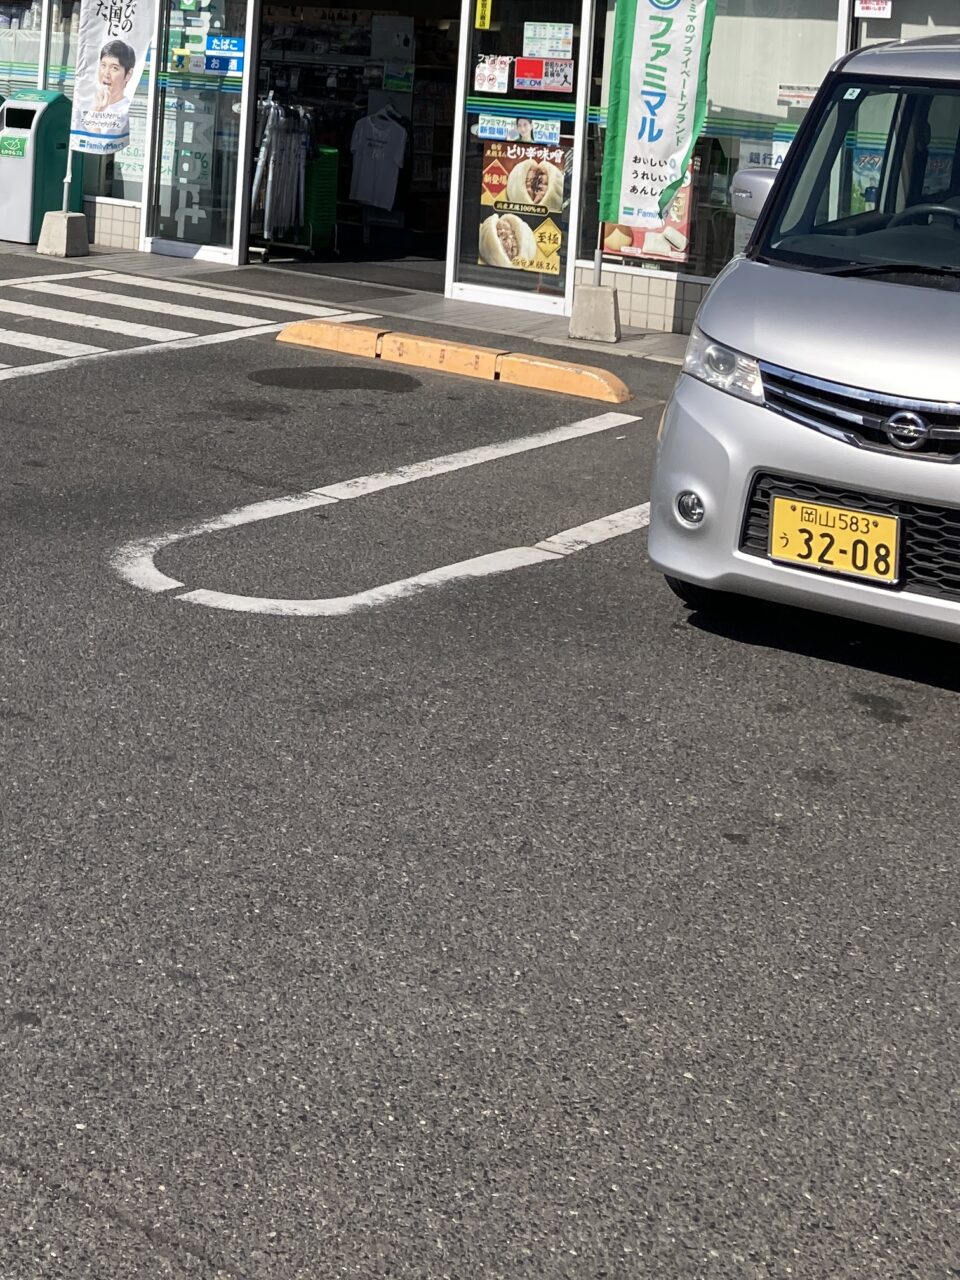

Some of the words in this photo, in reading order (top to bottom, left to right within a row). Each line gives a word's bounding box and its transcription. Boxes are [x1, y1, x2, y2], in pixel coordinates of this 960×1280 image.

[212, 38, 238, 50] たばこ
[638, 15, 673, 142] ファミマル
[85, 141, 124, 152] FamilyMart
[507, 144, 564, 163] ピリ辛味噌
[632, 155, 667, 167] おいしい
[484, 173, 507, 185] 新登場
[632, 170, 667, 182] うれしい
[537, 232, 559, 245] 至極
[779, 532, 789, 548] う
[797, 528, 890, 576] 32-08
